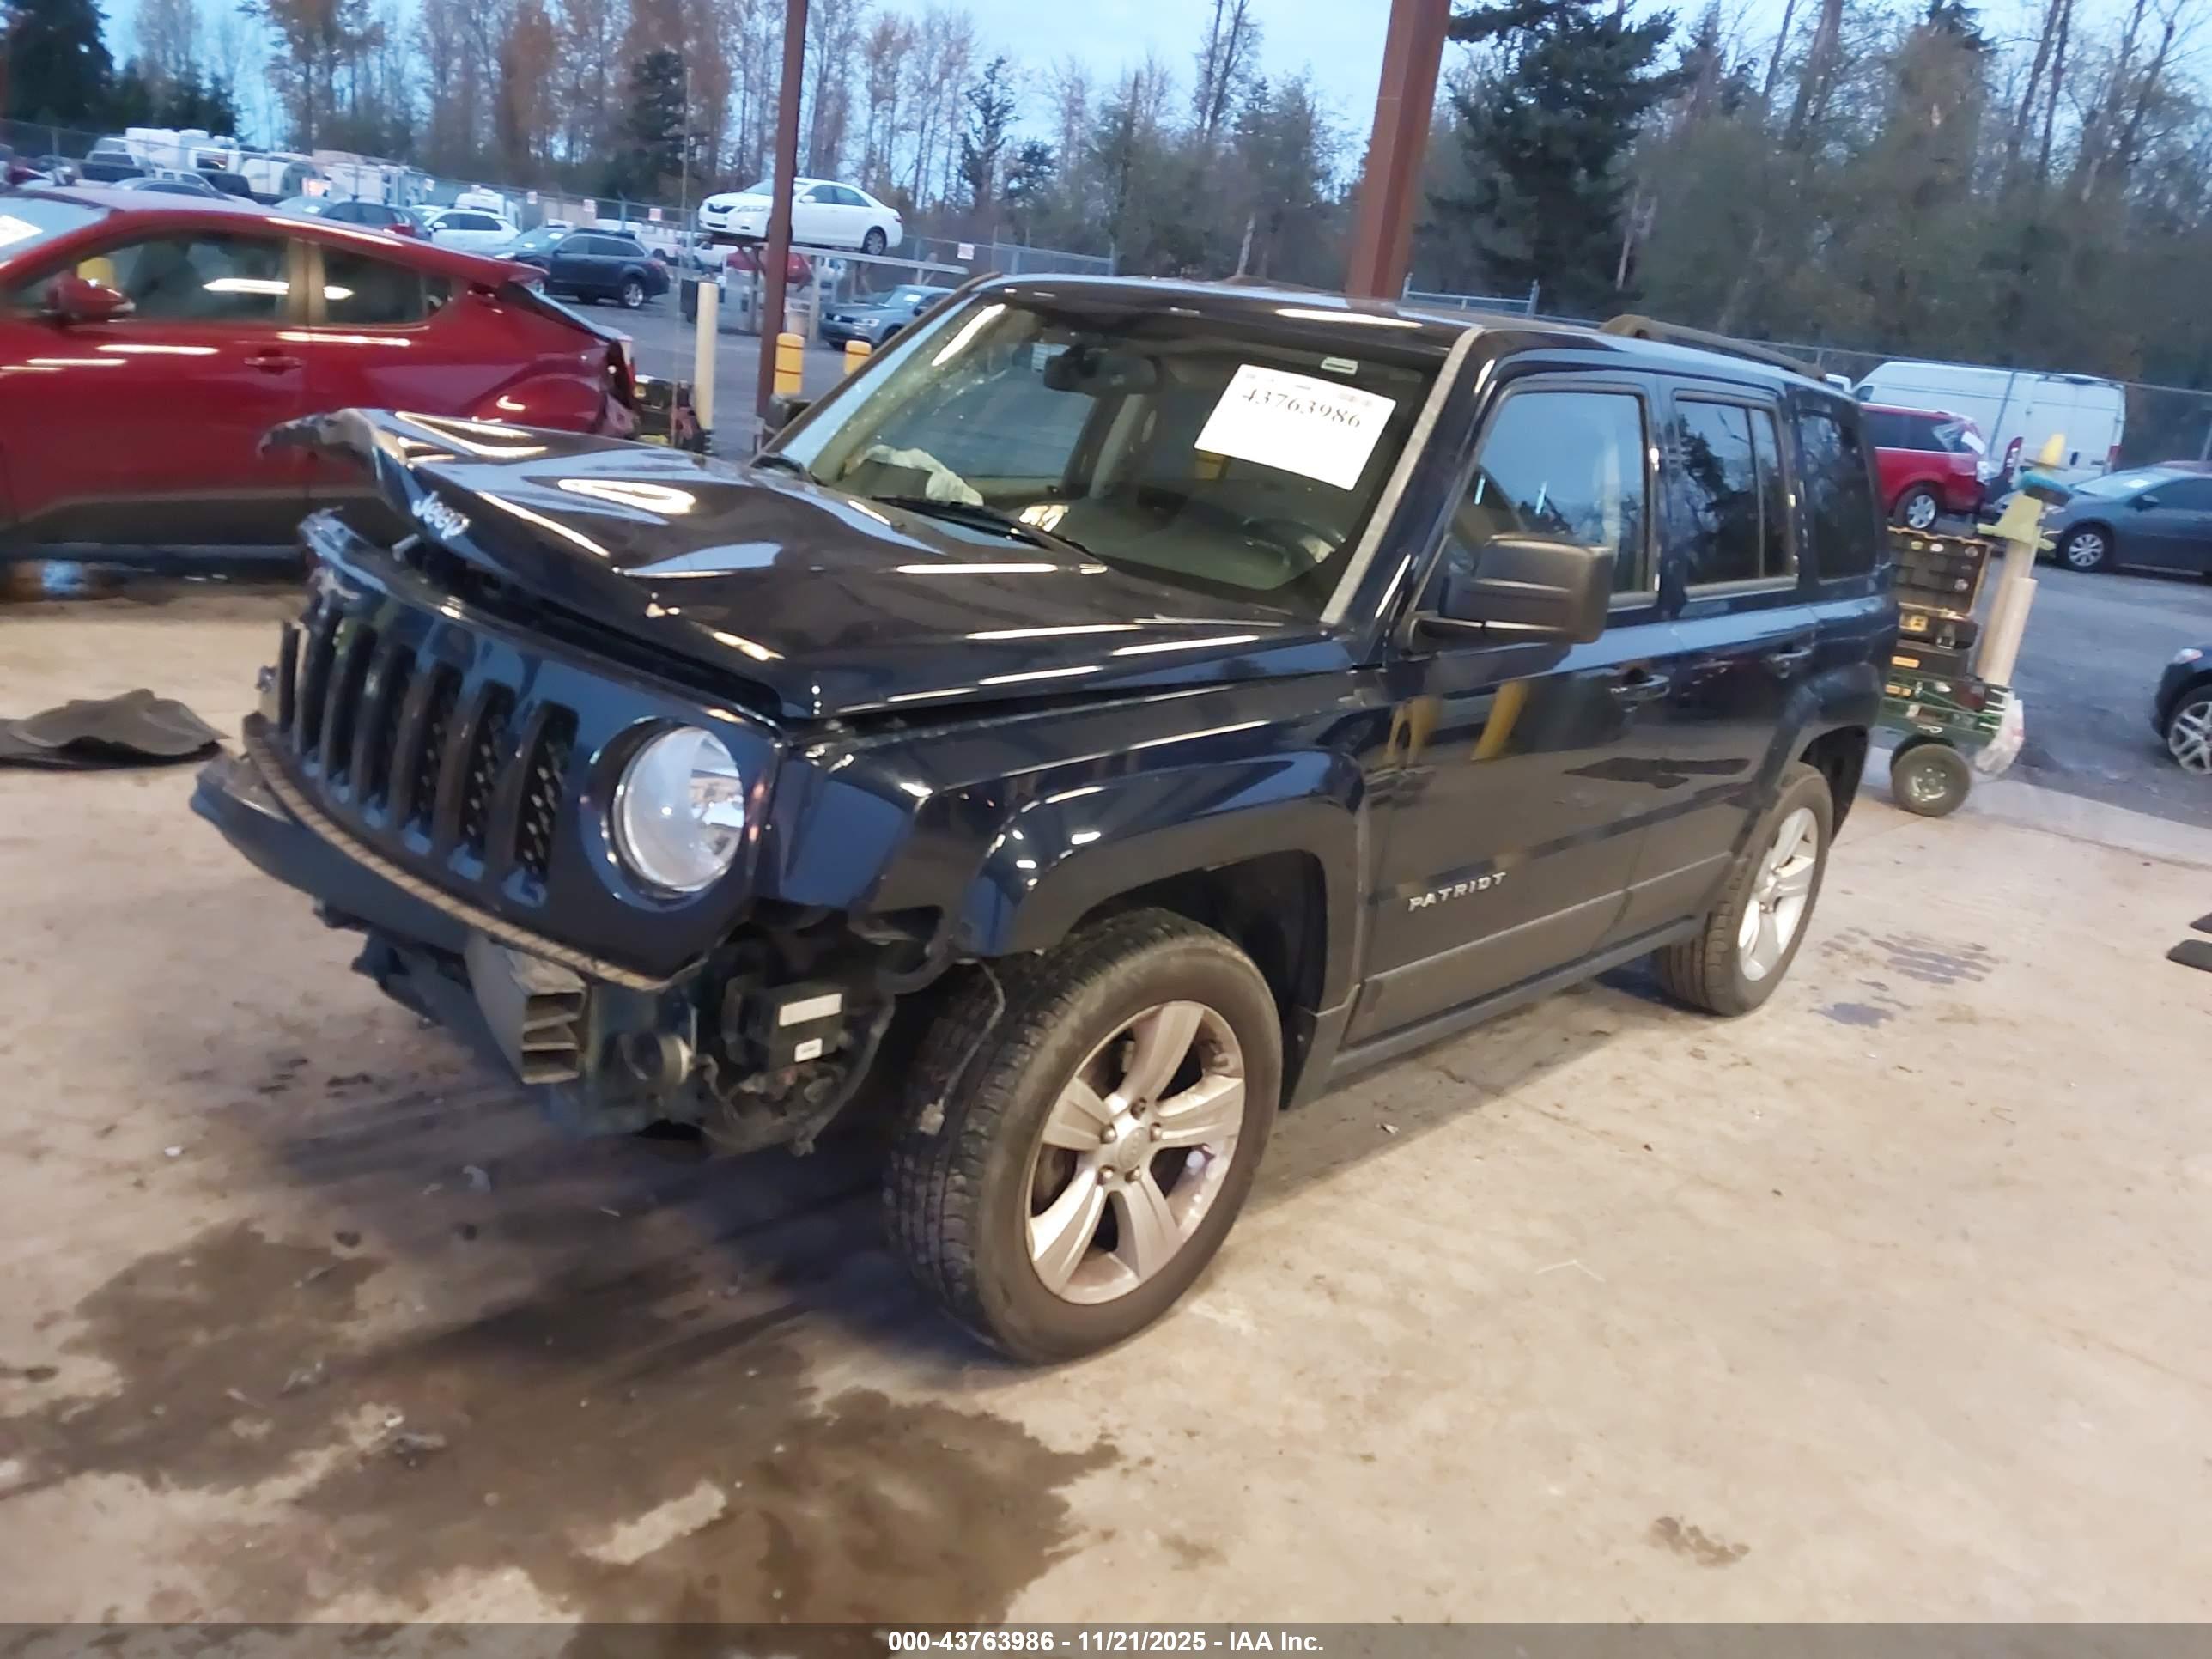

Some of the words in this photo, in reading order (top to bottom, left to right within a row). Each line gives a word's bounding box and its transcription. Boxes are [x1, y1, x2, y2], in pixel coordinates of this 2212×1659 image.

[1242, 387, 1361, 428] 43763986
[411, 489, 471, 541] Jeep
[1407, 872, 1507, 913] PATRIOT
